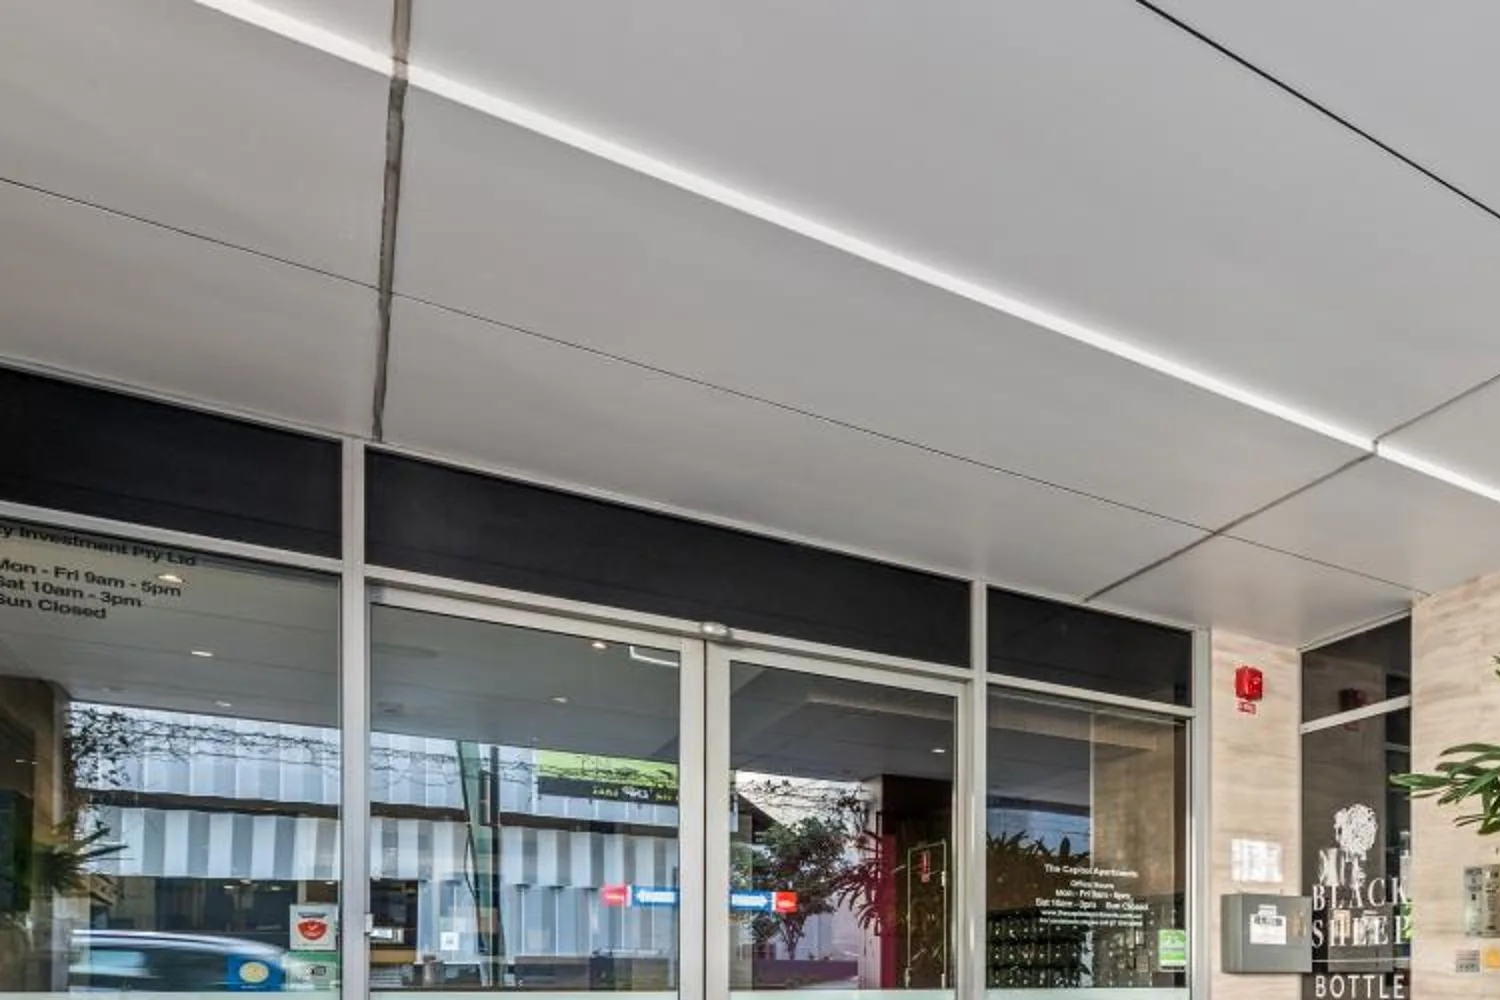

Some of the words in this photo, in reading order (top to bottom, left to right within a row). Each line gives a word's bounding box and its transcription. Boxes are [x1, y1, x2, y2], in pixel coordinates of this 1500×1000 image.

[20, 527, 129, 554] Investment
[132, 544, 161, 563] Pty
[167, 552, 197, 566] Ltd
[32, 580, 84, 599] 10am
[100, 591, 142, 608] 3pm
[54, 565, 79, 581] Fri
[84, 571, 125, 588] 9am
[141, 580, 182, 597] 5pm
[38, 599, 107, 619] Closed
[1312, 875, 1410, 911] BLACK
[1311, 912, 1410, 949] SHEEP
[1315, 973, 1405, 999] BOTTLE
